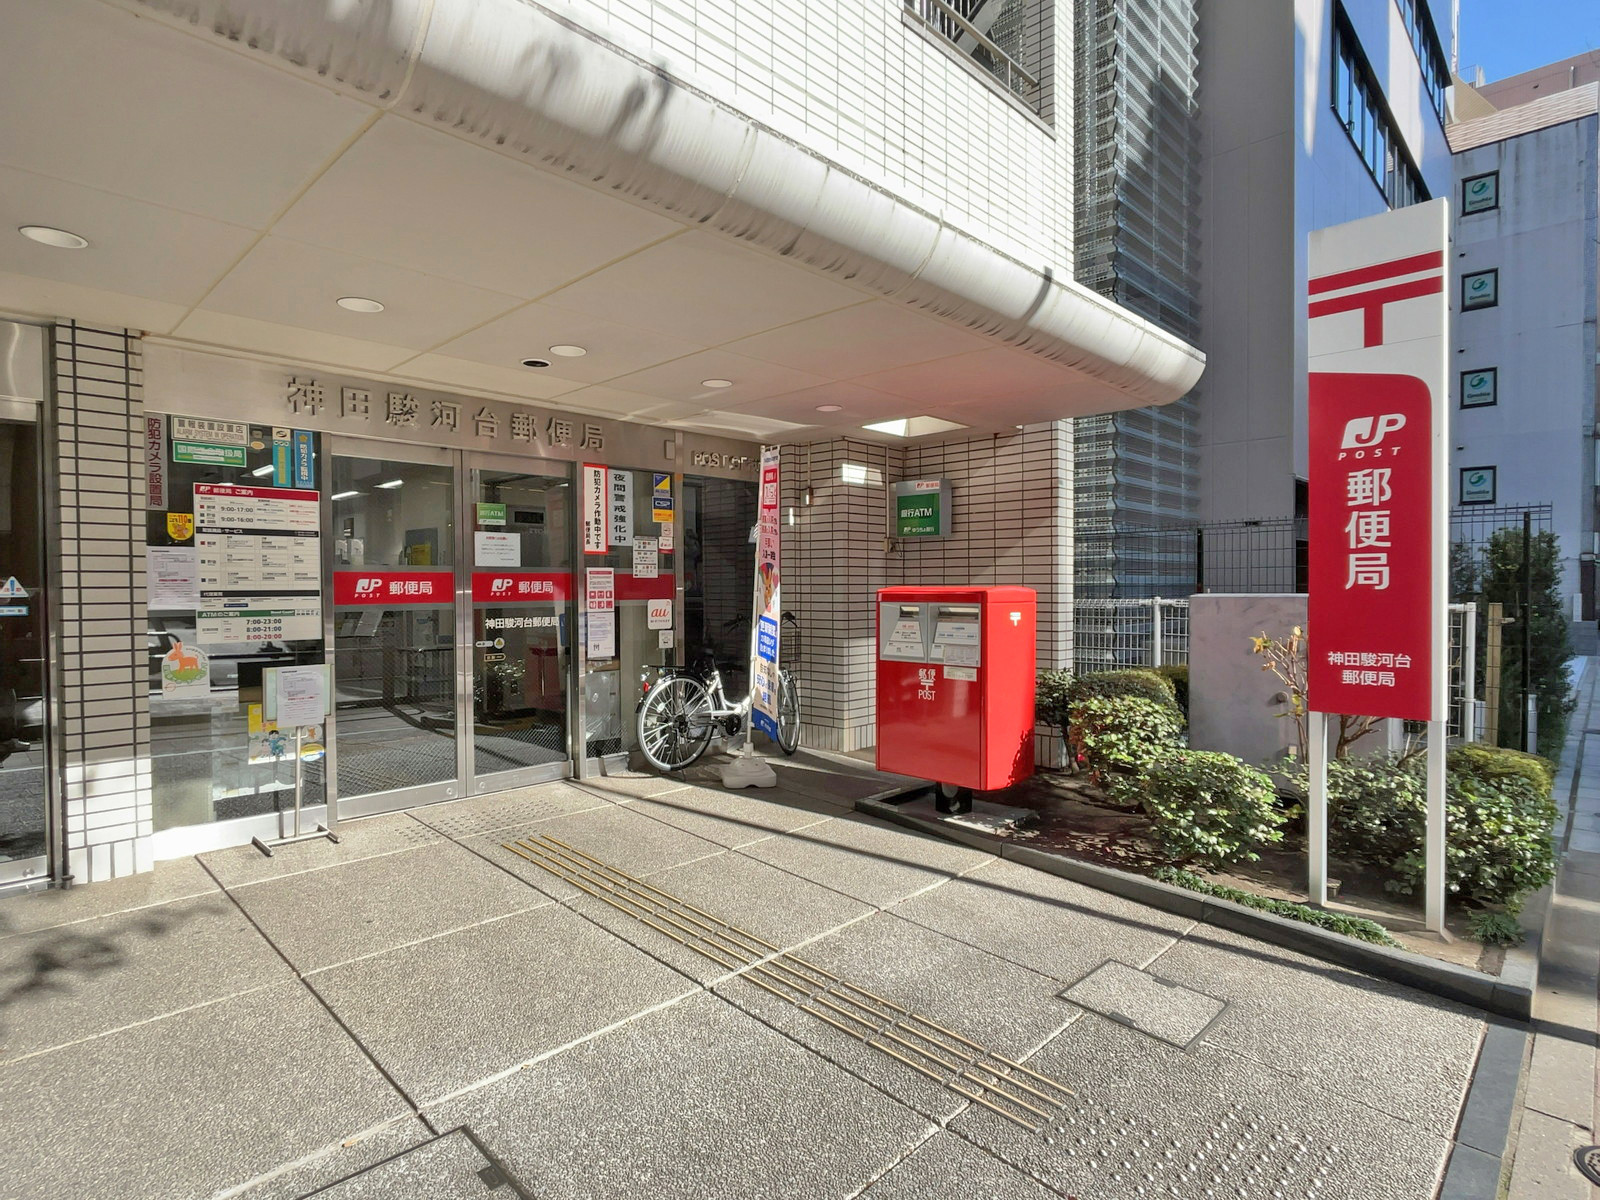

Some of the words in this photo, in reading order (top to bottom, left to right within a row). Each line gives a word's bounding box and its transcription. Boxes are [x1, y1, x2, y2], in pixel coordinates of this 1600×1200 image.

[287, 377, 605, 451] 神田駿河台郵便局
[692, 451, 728, 468] POST
[1338, 446, 1401, 460] POST
[147, 418, 163, 507] 防犯カメラ設置局
[593, 470, 601, 549] 防犯カメラ作動中です
[613, 473, 626, 543] 夜間警戒強化中
[1345, 468, 1392, 590] 郵便局
[389, 581, 432, 595] 郵便局
[519, 581, 553, 594] 郵便局
[651, 608, 669, 618] au
[485, 616, 560, 629] 神田駿河台郵便局
[1327, 651, 1412, 669] 神田駿河台
[918, 668, 936, 681] 郵便
[1341, 670, 1395, 688] 郵便局
[918, 690, 936, 701] POST
